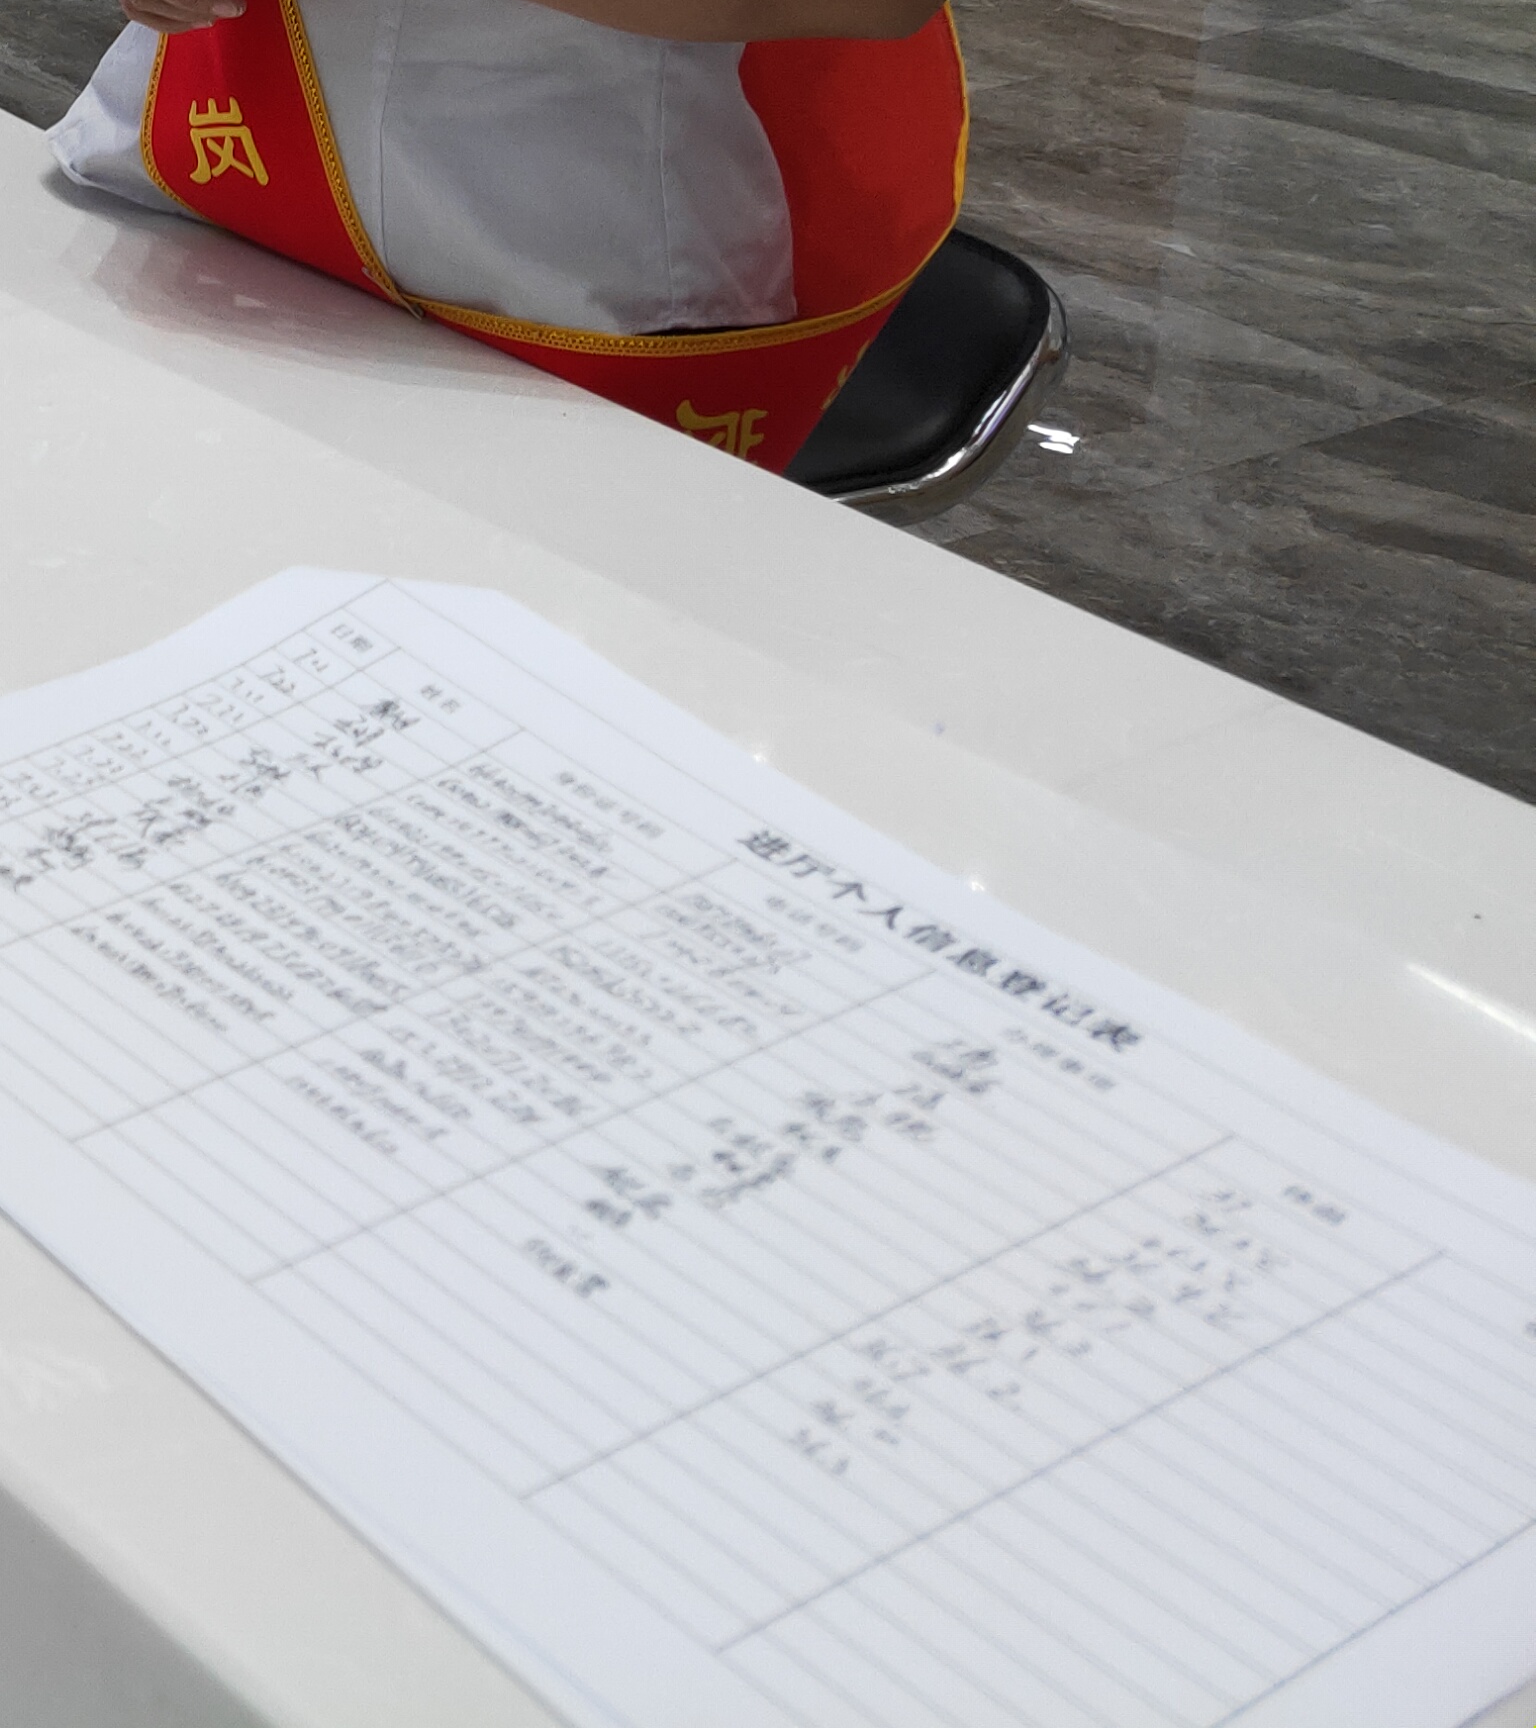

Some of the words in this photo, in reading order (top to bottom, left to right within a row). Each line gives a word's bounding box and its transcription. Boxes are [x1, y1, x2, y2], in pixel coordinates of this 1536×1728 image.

[737, 828, 1142, 1054] 进厅个人信息登记表
